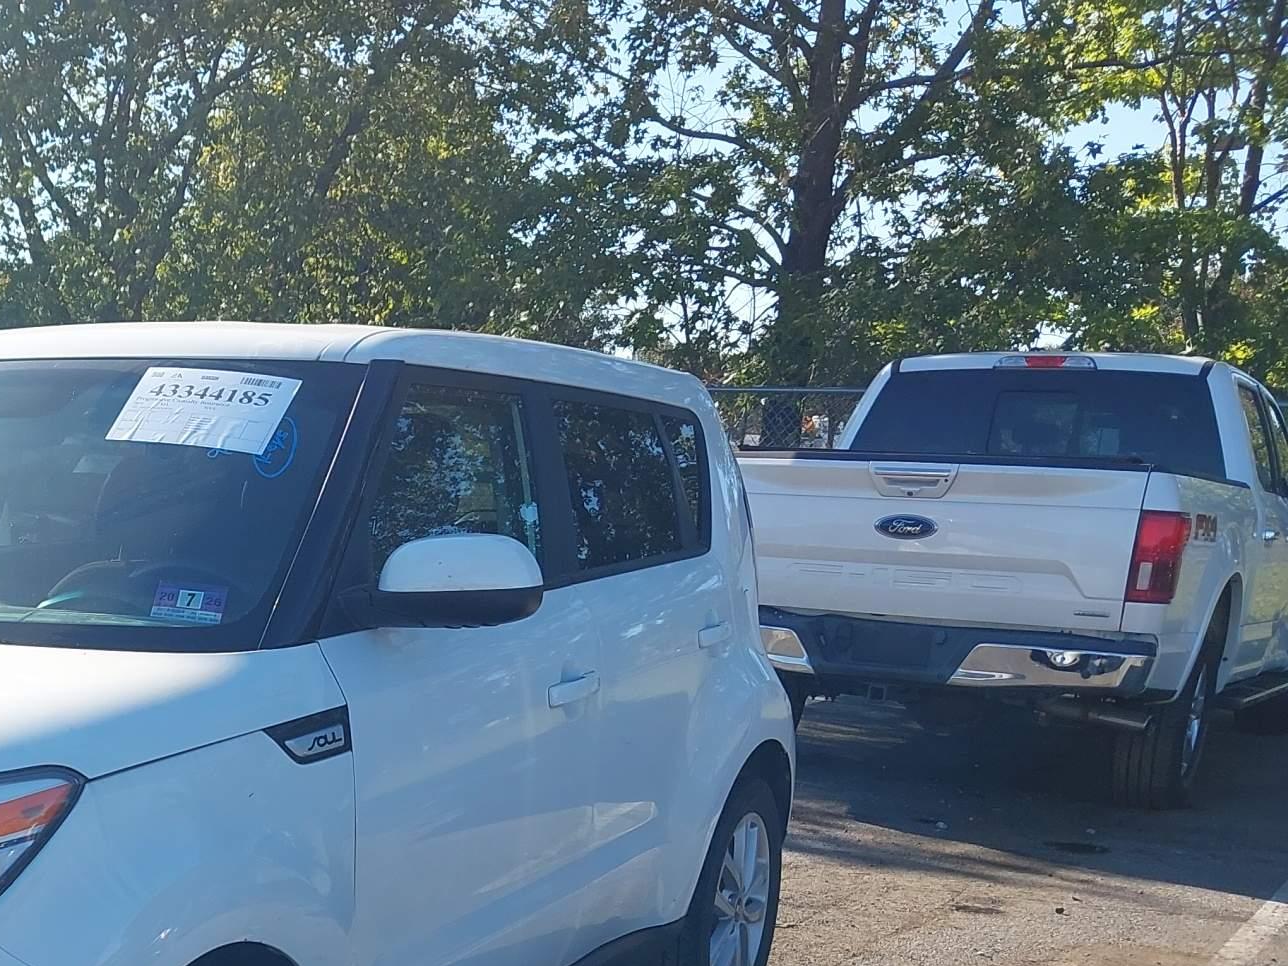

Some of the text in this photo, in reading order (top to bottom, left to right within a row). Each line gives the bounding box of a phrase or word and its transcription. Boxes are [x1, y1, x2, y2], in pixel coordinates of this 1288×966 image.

[149, 383, 273, 407] 43344185
[888, 519, 923, 534] Ford
[159, 592, 175, 601] 20
[187, 593, 196, 606] 7
